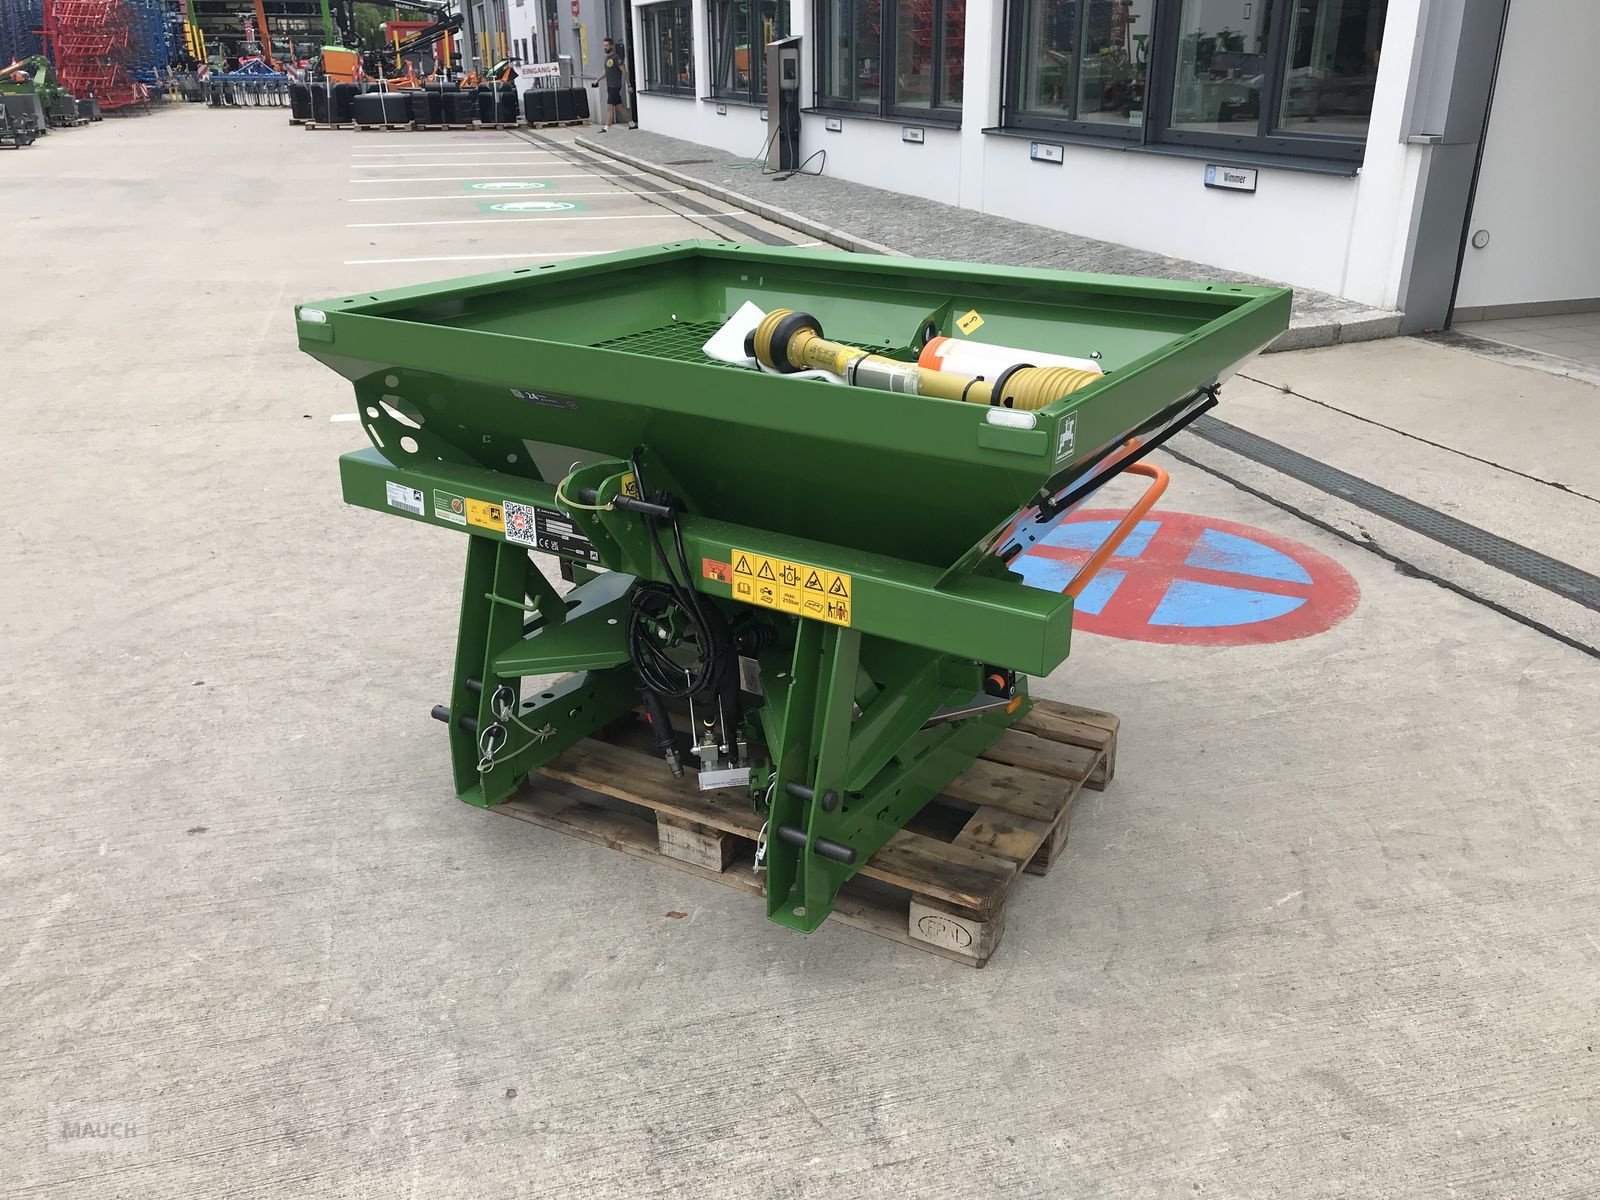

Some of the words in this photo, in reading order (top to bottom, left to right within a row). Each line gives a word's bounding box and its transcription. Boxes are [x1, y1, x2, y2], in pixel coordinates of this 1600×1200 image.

[522, 66, 552, 75] EINGANG
[1224, 172, 1247, 184] Wimmer
[538, 538, 550, 549] CE
